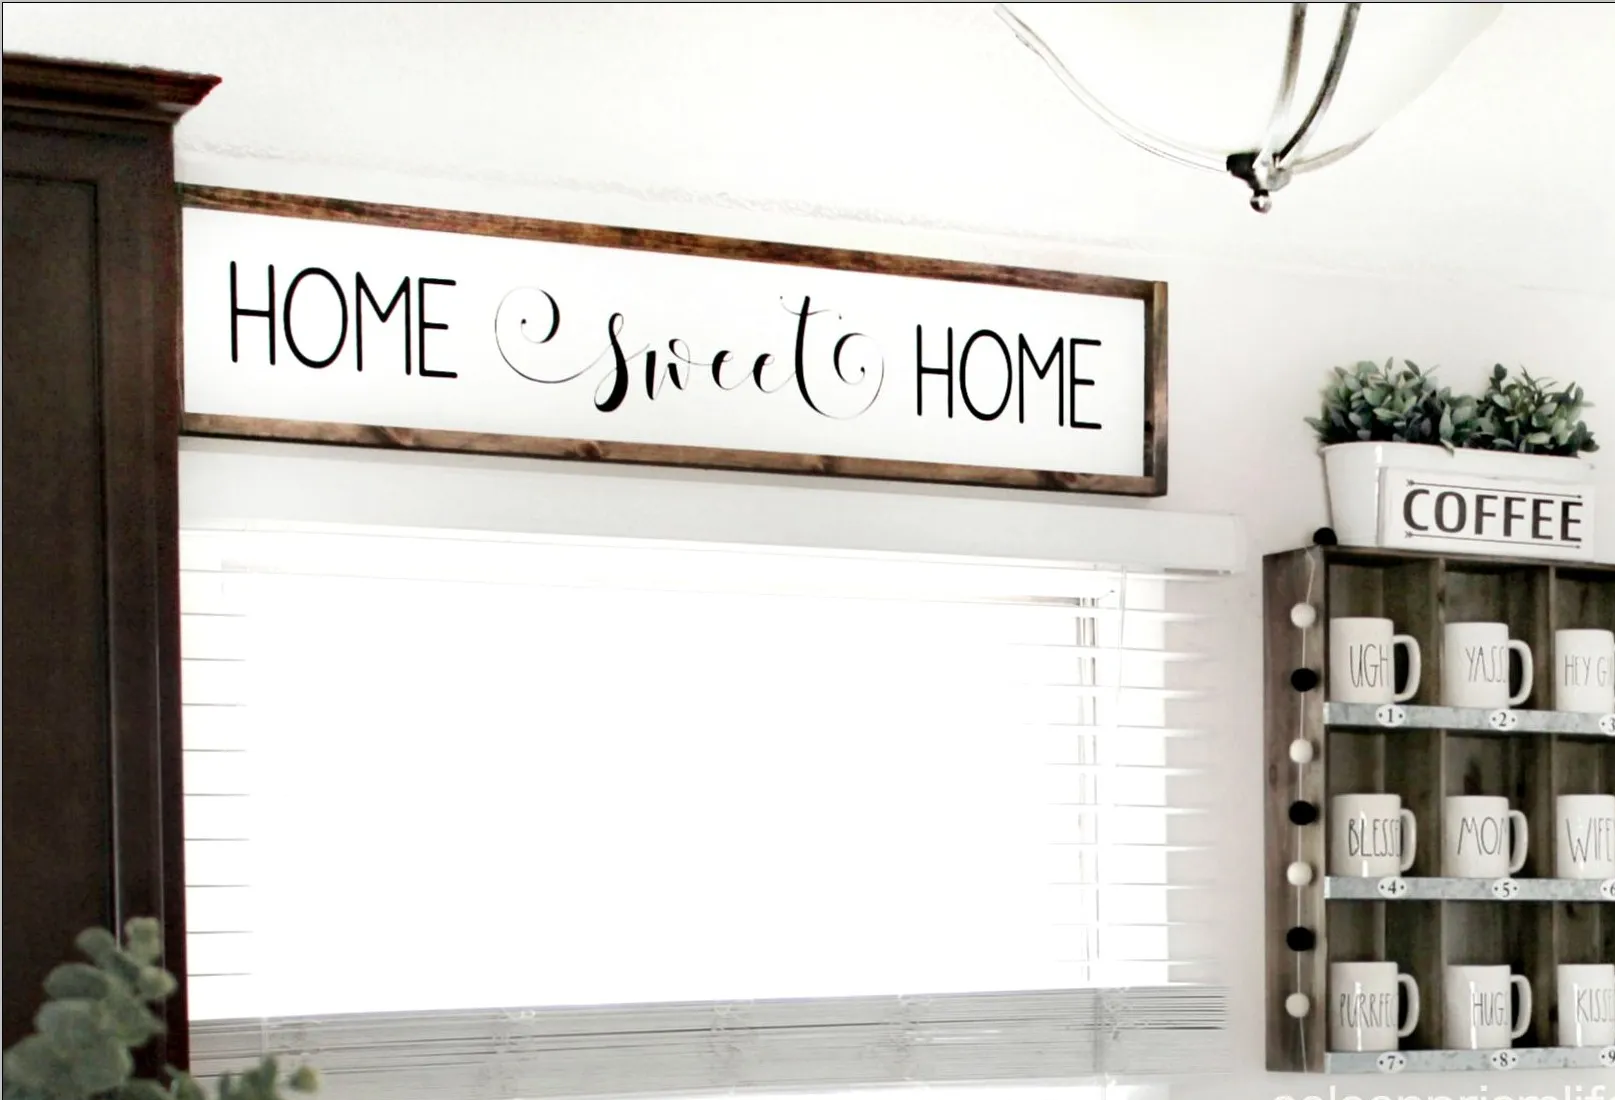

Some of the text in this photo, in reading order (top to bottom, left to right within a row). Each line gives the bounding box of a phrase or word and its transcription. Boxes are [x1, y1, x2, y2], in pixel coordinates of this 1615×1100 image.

[229, 260, 1103, 430] HOME sweet HOME
[1403, 488, 1584, 542] COFFEE
[1498, 713, 1507, 728] 2
[1388, 881, 1397, 895] 4
[1502, 883, 1510, 898] 5
[1387, 1055, 1396, 1069] 7
[1499, 1052, 1508, 1067] 8
